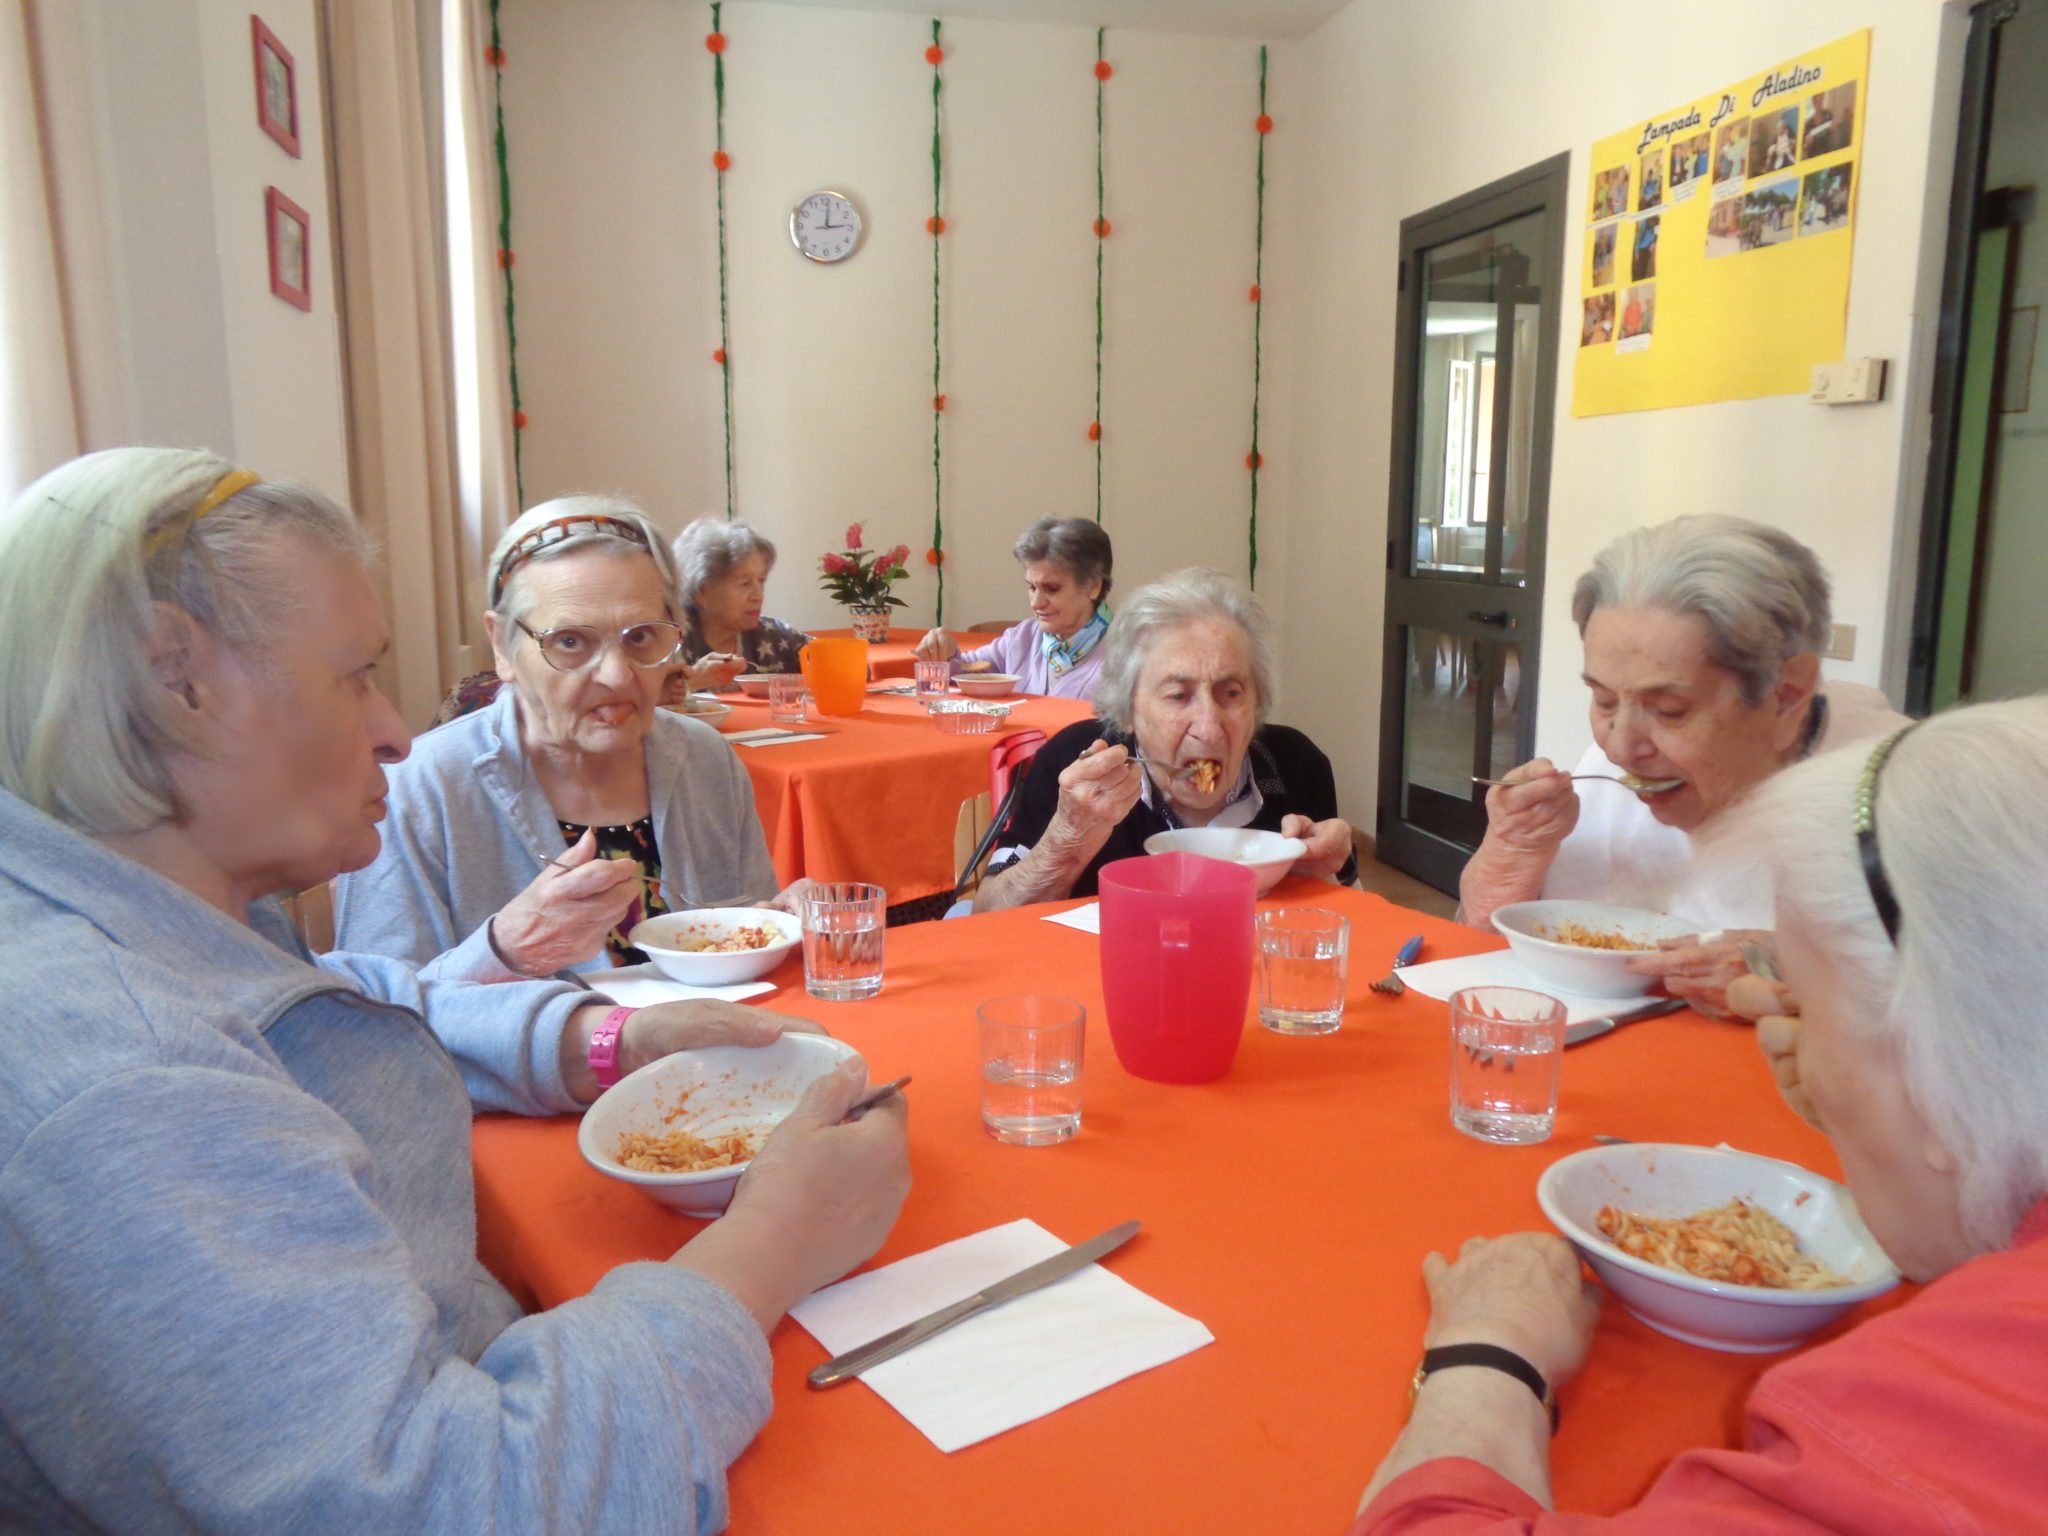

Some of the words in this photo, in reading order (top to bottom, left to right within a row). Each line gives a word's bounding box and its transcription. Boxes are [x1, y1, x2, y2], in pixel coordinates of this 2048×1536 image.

[1637, 107, 1701, 154] Lampada
[1709, 94, 1735, 127] Di
[1752, 65, 1821, 107] Aladino
